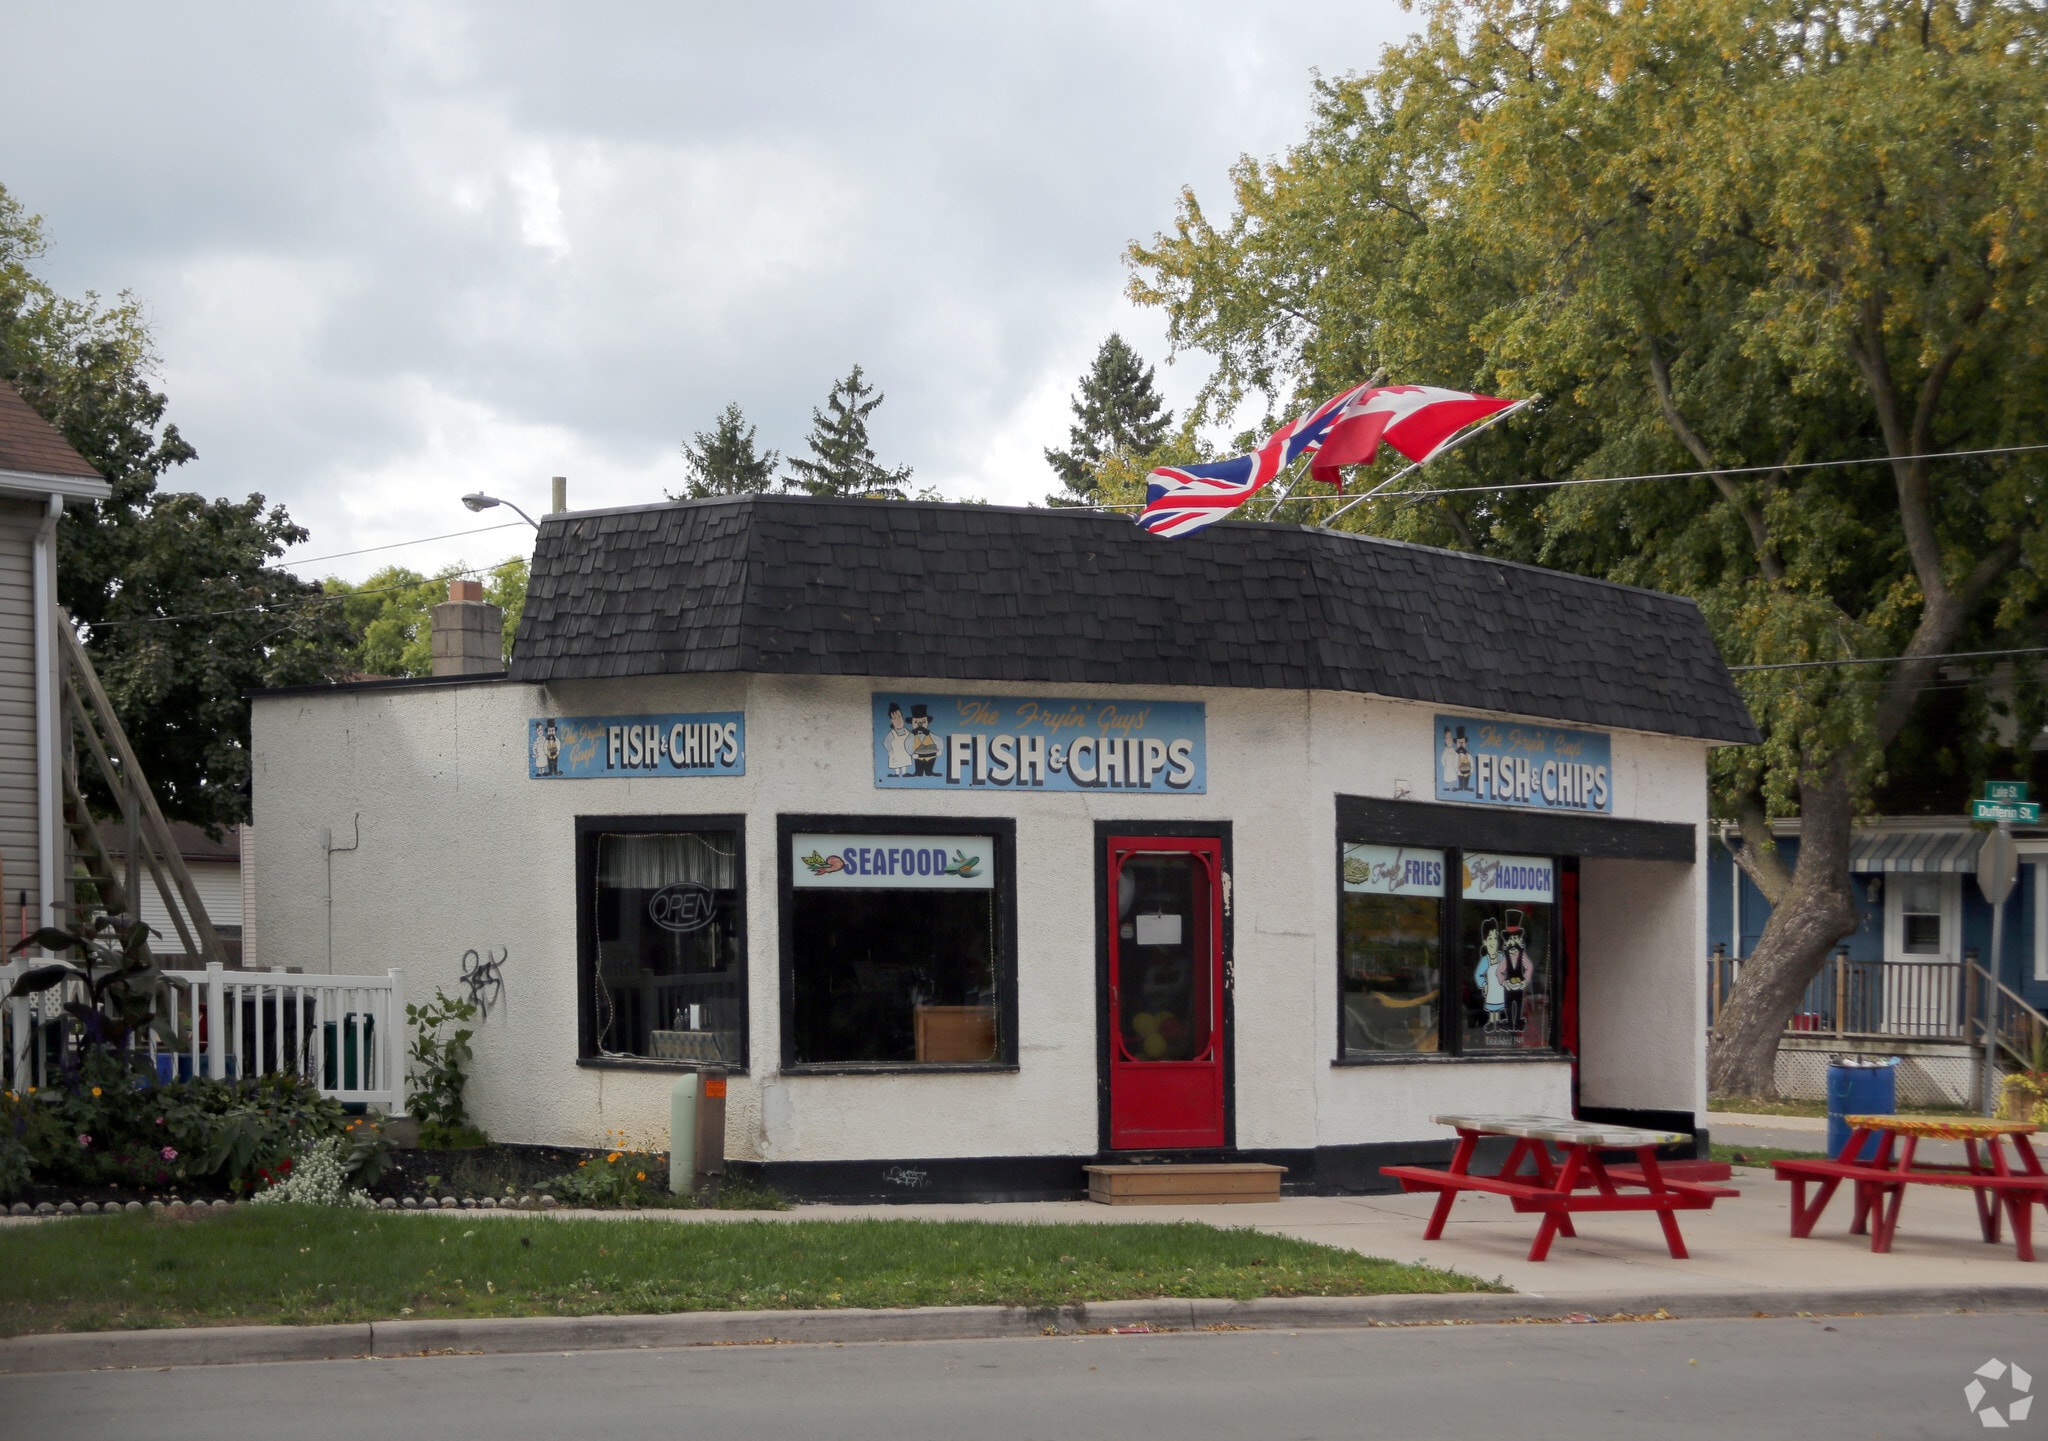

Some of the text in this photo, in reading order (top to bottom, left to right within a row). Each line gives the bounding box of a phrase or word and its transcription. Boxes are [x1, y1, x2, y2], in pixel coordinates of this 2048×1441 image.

[607, 725, 659, 769] FISH
[668, 722, 738, 769] CHIPS
[946, 733, 1044, 786] FISH
[1067, 736, 1195, 789] CHIPS
[1476, 753, 1530, 802] FISH
[1541, 760, 1608, 809] CHIPS
[1992, 786, 2008, 798] Lake
[1978, 804, 2034, 819] Dufferin St.
[843, 847, 948, 876] SEAFOOD
[1404, 859, 1441, 887] FRIES
[1496, 864, 1551, 892] HADDOCK
[651, 892, 715, 920] OPEN
